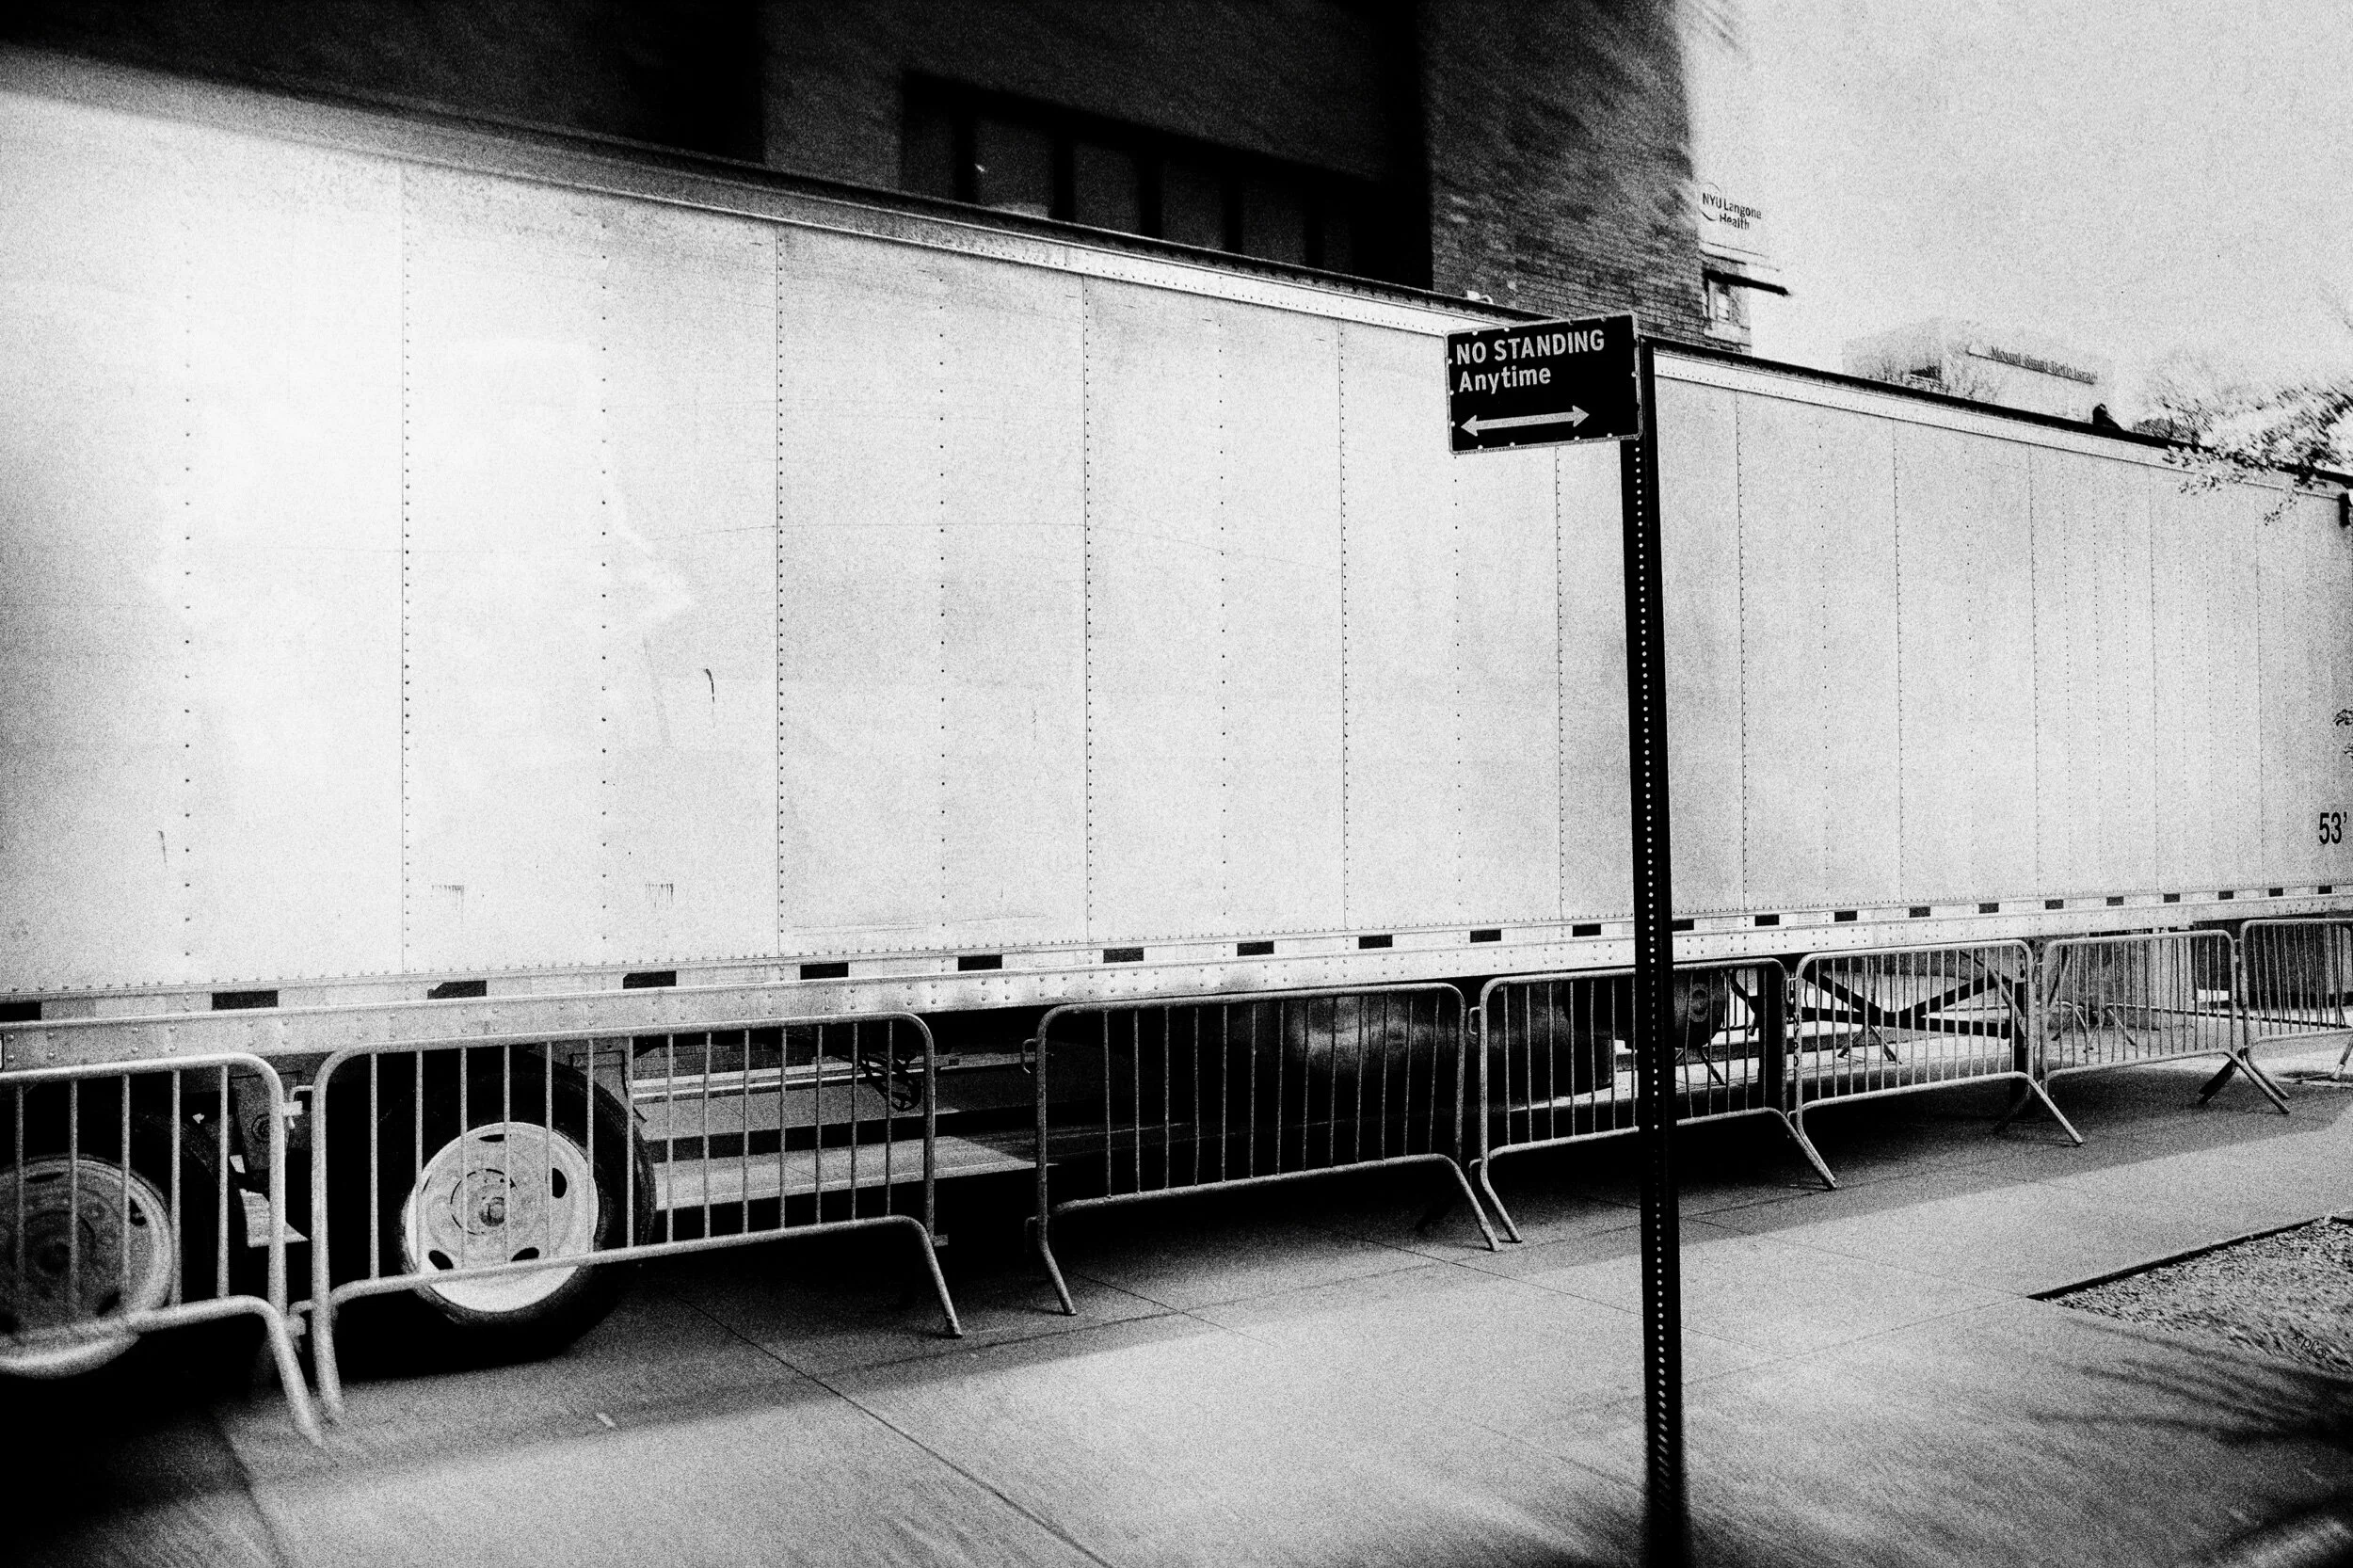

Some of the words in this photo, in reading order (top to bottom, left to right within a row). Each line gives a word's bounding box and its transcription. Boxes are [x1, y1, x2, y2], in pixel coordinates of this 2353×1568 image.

[1702, 192, 1721, 209] NYU
[1723, 198, 1761, 219] Langone
[1720, 213, 1750, 230] Health
[1456, 342, 1486, 365] NO
[1494, 329, 1605, 361] STANDING
[1459, 365, 1551, 394] Anytime
[2319, 811, 2347, 844] 53'
